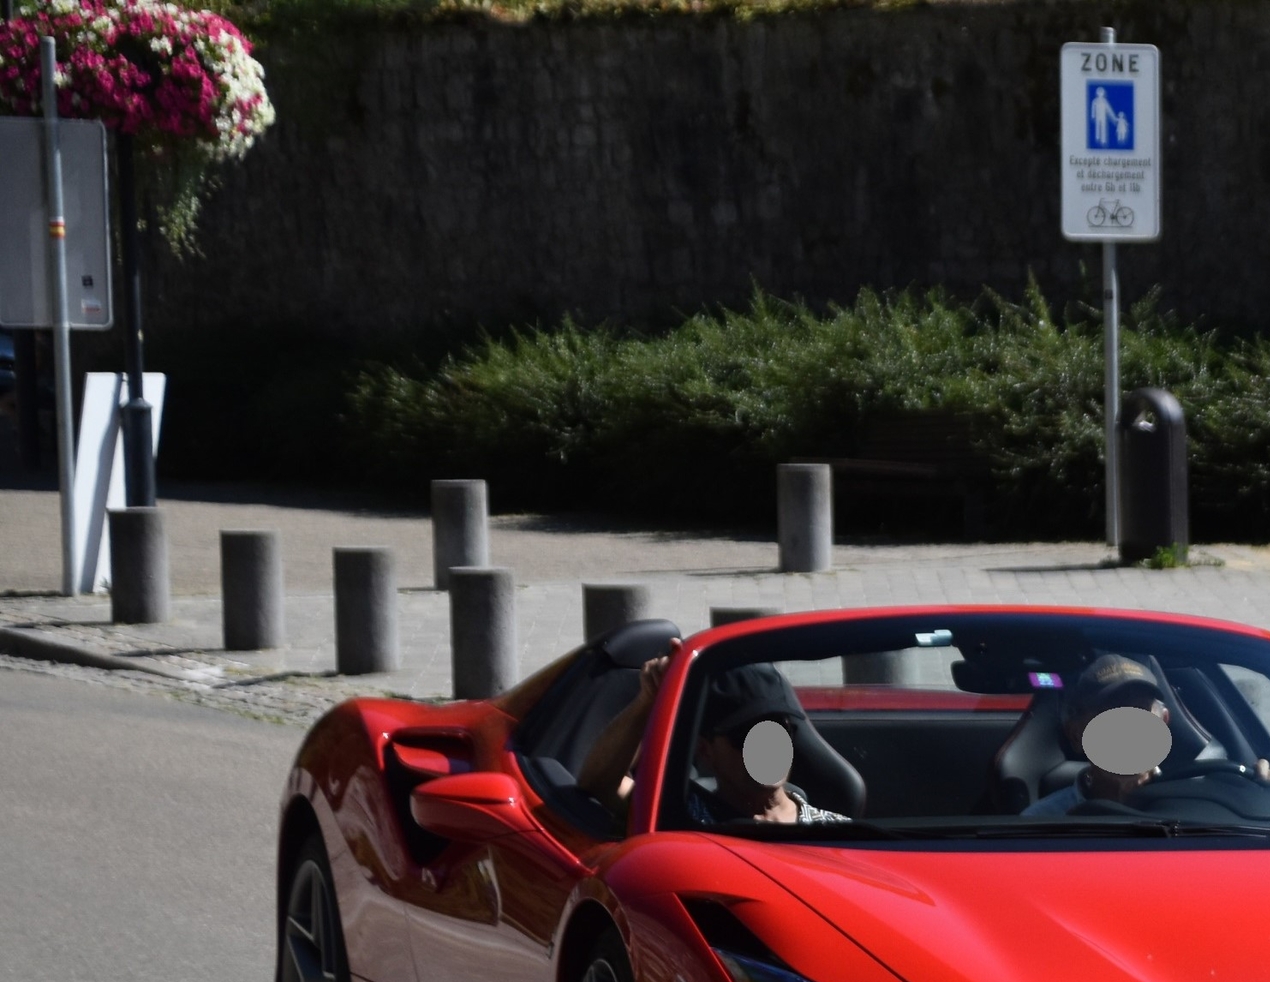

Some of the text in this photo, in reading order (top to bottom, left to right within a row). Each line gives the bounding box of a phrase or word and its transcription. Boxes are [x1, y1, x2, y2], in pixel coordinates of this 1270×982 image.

[1081, 53, 1139, 72] ZONE
[1104, 156, 1151, 168] chargement
[1077, 169, 1084, 178] et
[1081, 182, 1102, 192] entre
[1118, 183, 1126, 192] et
